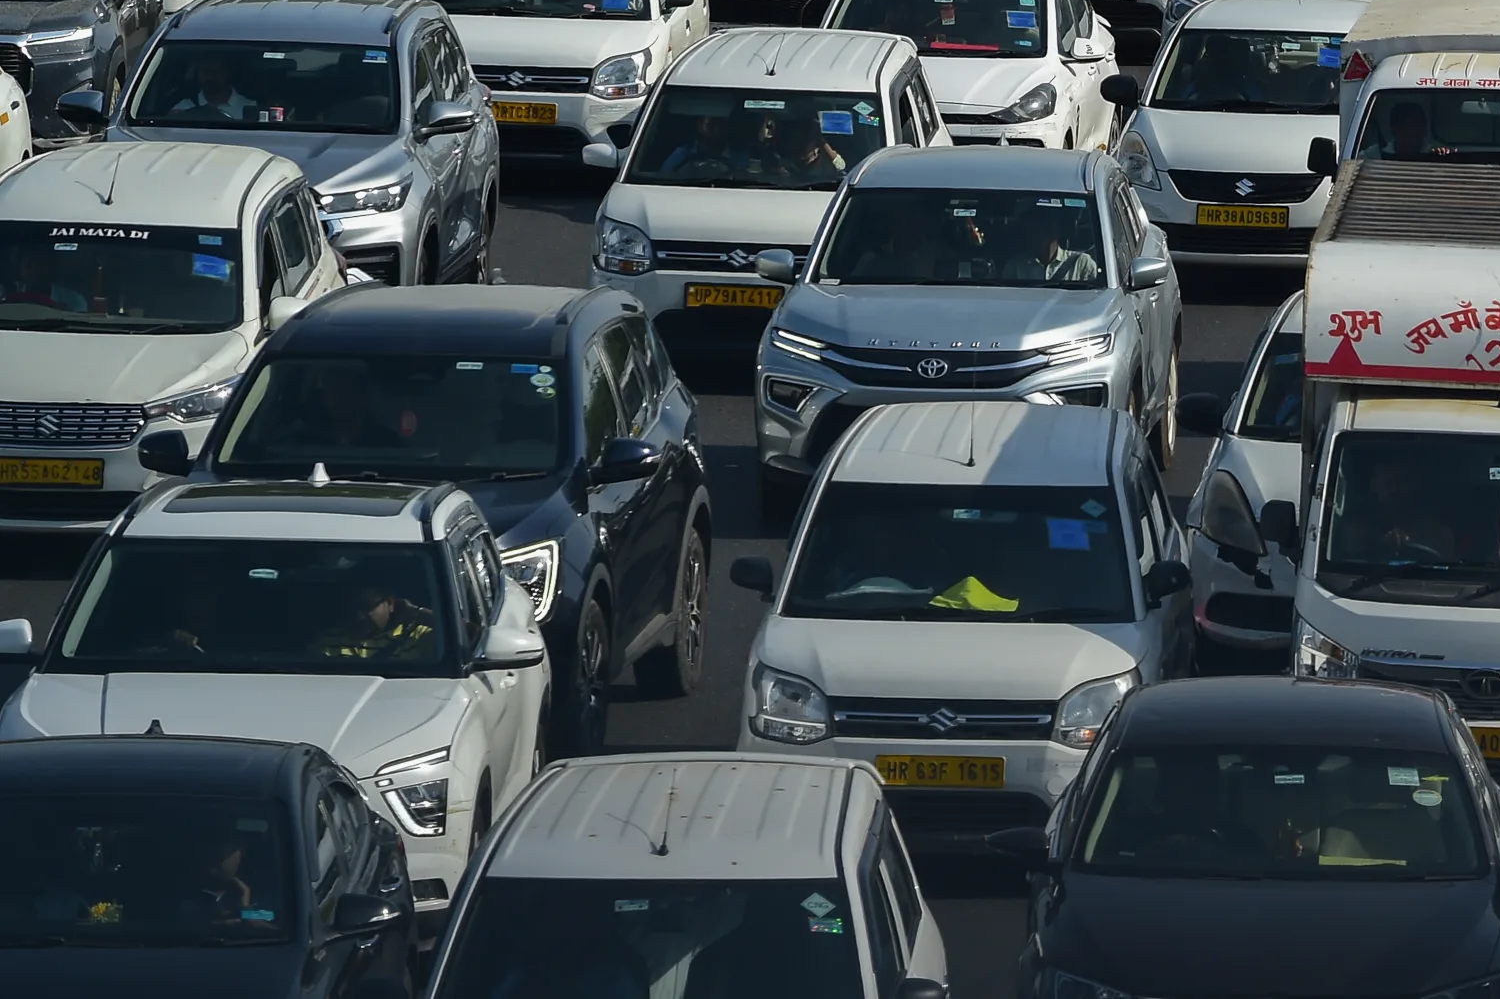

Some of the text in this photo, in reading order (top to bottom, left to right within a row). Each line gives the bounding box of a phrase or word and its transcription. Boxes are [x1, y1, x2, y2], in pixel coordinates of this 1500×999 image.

[1206, 207, 1286, 224] HR38AD9698
[51, 228, 149, 239] JAI MATA DI
[1328, 310, 1383, 342] शुभ
[887, 762, 1001, 782] HR 63F 1615
